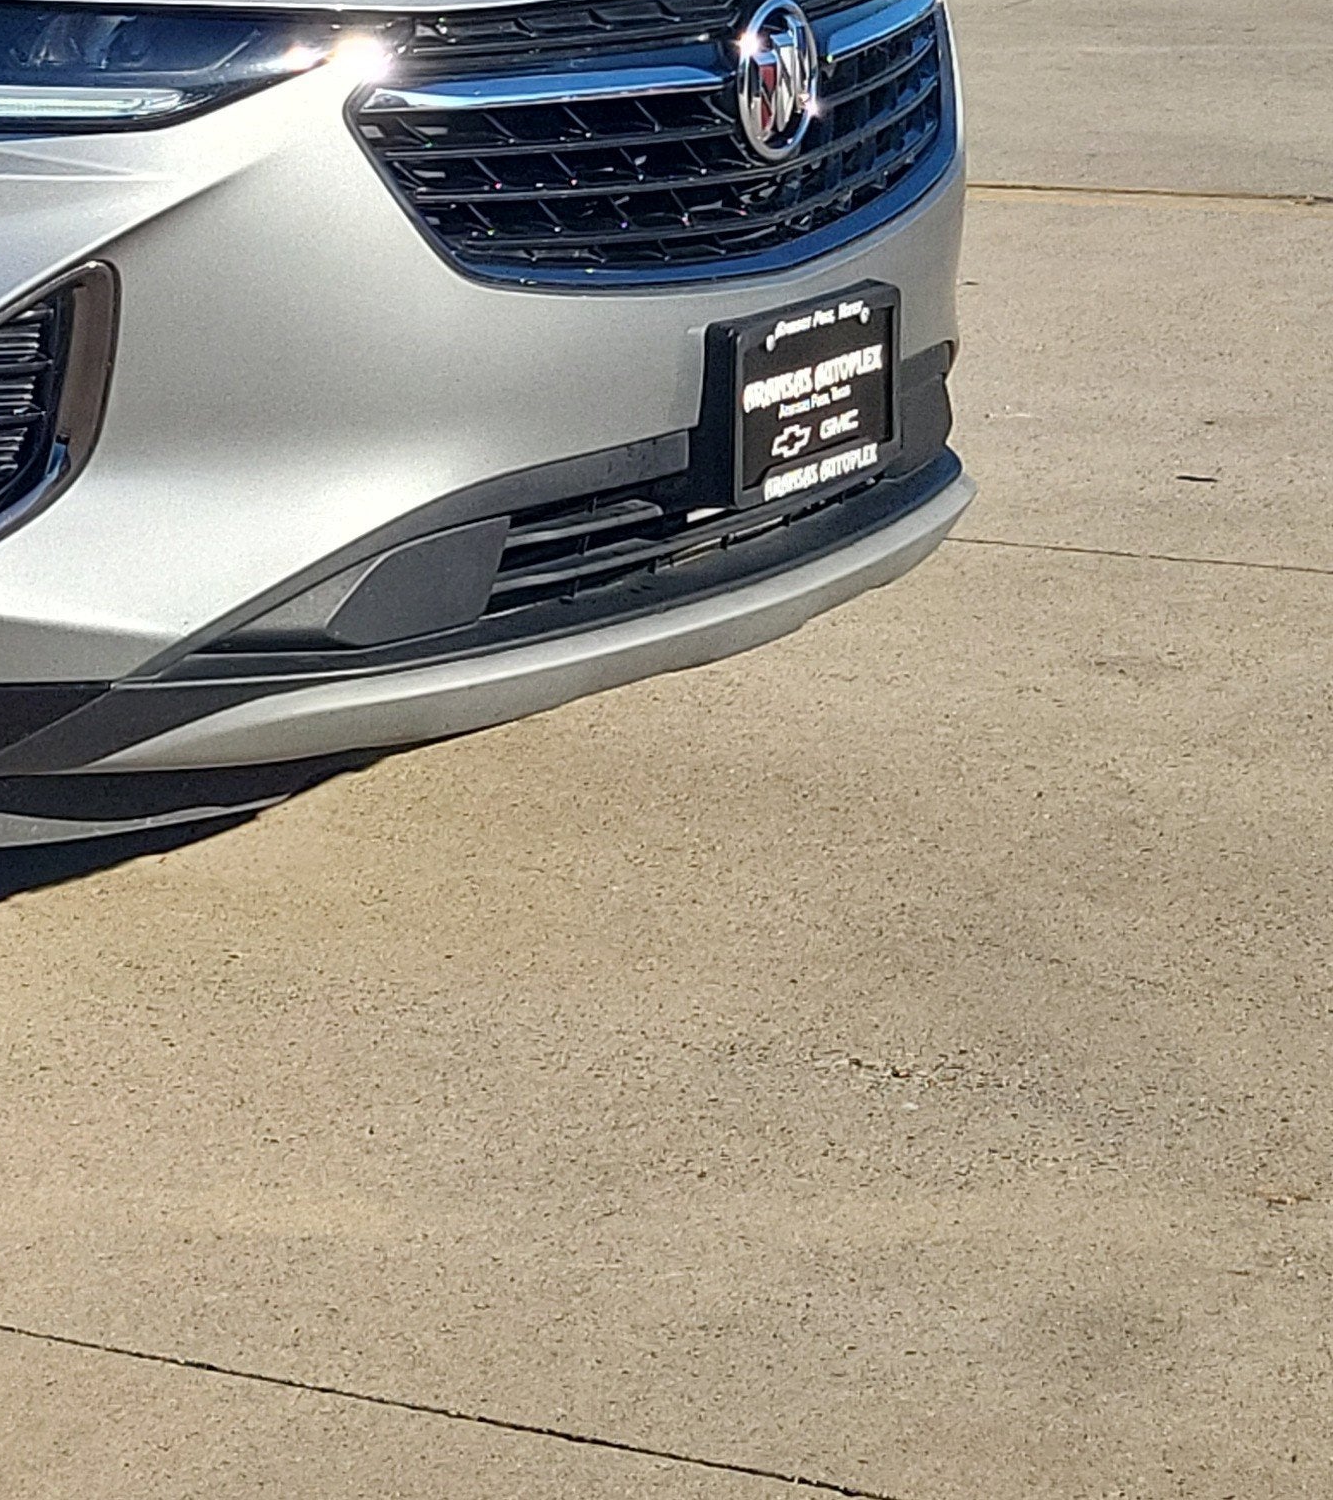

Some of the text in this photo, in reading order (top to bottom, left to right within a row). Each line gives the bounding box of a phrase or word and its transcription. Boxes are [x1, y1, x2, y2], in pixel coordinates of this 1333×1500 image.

[742, 344, 883, 413] ARANSAS AUTOPLEX
[819, 408, 859, 440] GMC
[763, 442, 878, 502] ARANSAS AUTOPLEX
